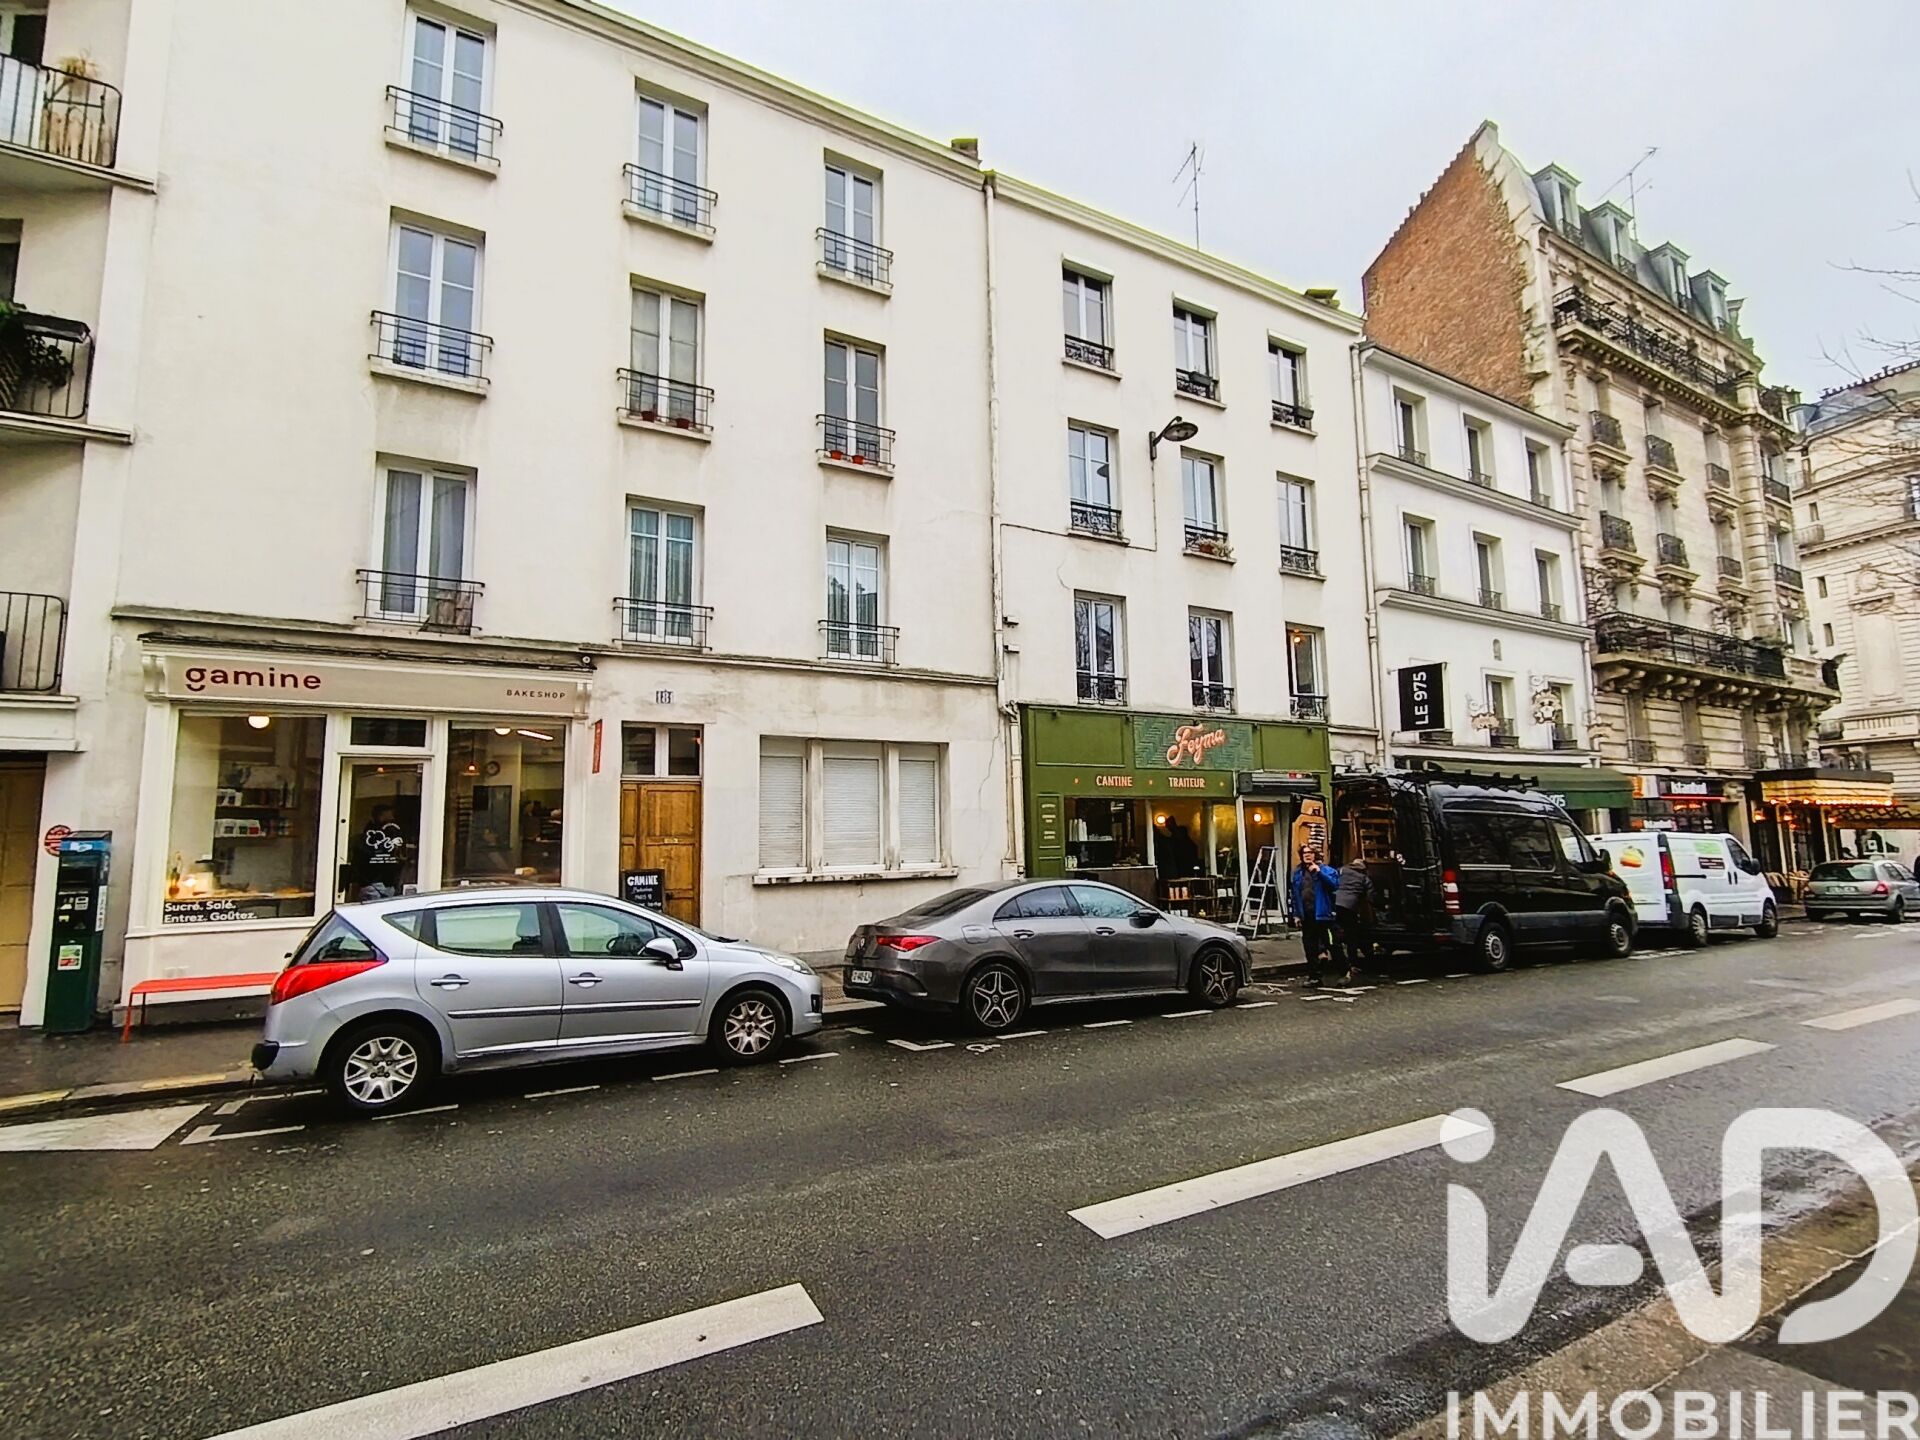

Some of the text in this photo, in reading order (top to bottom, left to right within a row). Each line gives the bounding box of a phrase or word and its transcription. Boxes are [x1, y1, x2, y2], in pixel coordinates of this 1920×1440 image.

[185, 667, 321, 692] gamine
[506, 689, 566, 699] BAKESHOP
[1412, 671, 1429, 725] LE 975
[1166, 723, 1228, 767] Feyma
[1096, 775, 1206, 788] CANTINE TRAITEUR
[164, 899, 237, 912] Sucré. Salé.
[164, 911, 258, 923] Entrez. Goûtez.
